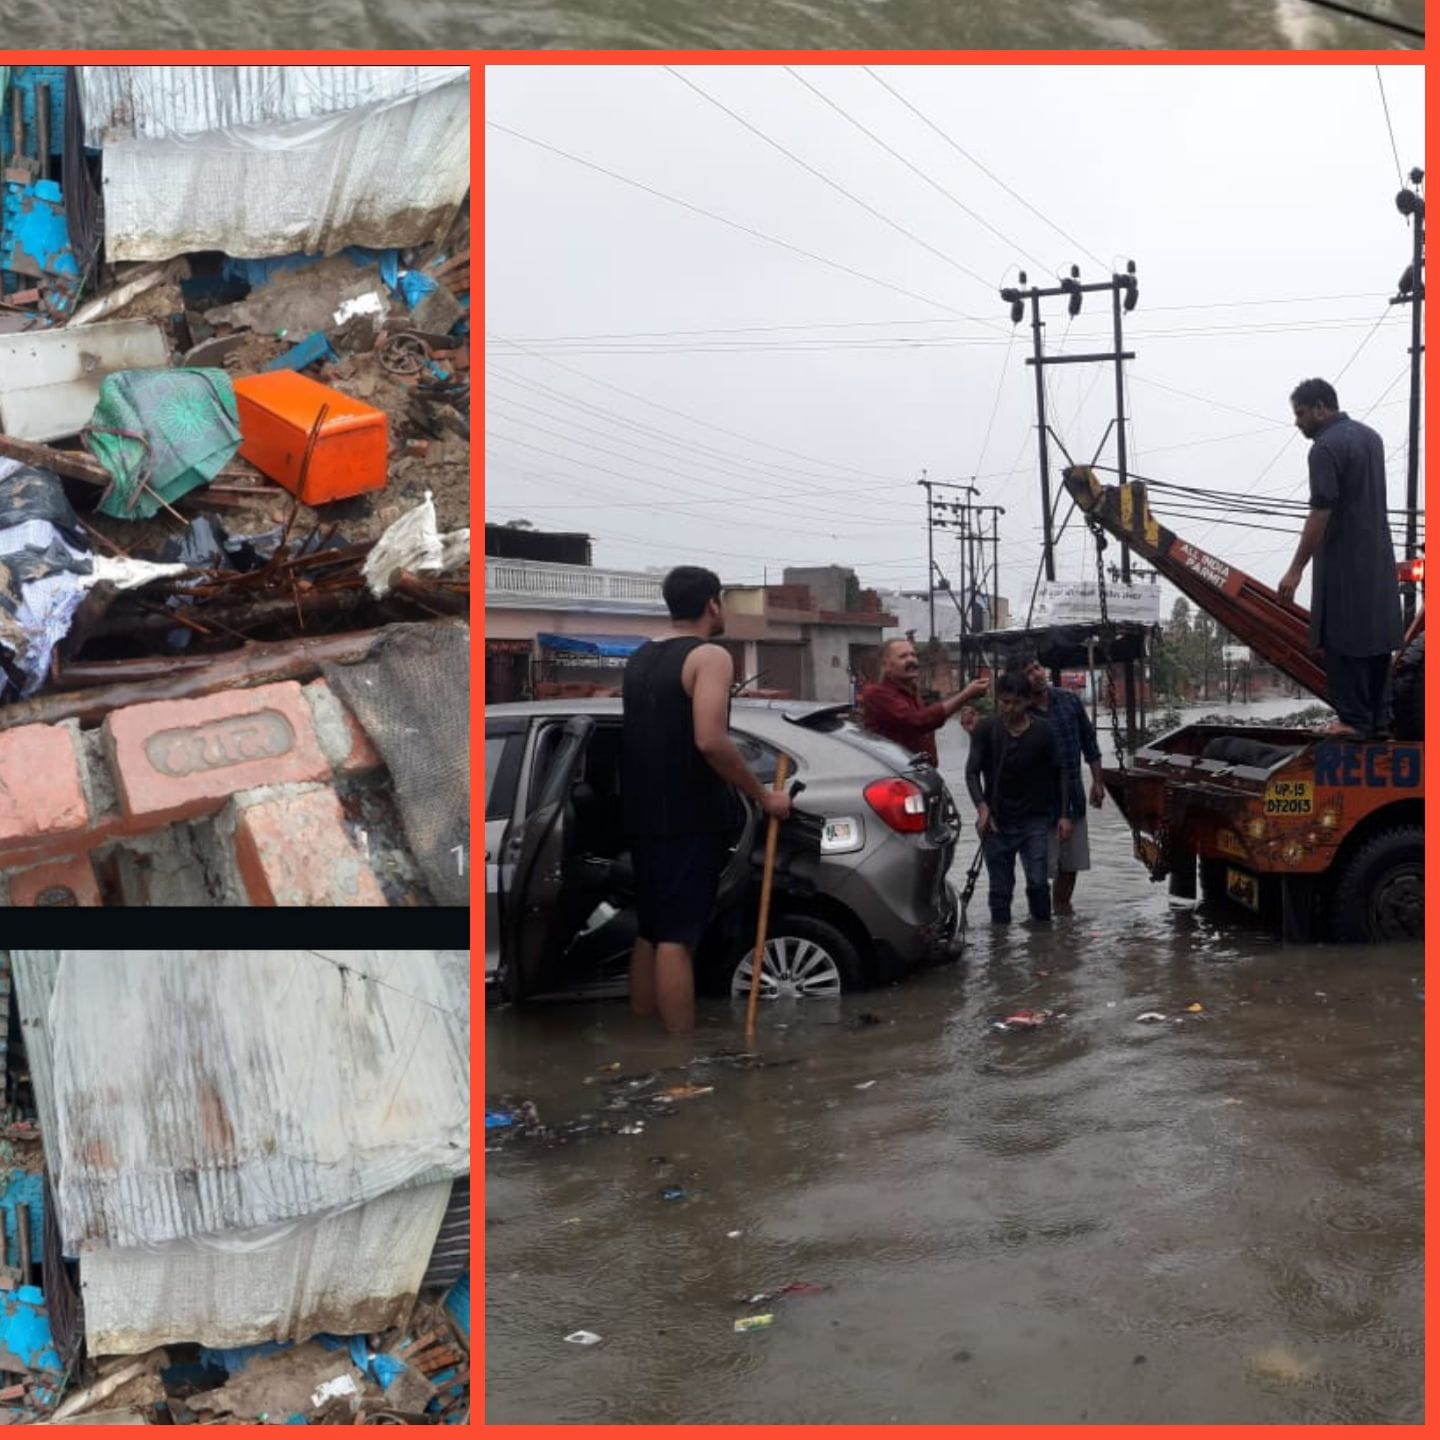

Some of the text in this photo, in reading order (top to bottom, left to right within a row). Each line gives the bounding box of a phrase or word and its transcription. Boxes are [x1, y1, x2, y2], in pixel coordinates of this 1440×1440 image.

[1180, 544, 1229, 577] ALL INDIA
[1314, 741, 1421, 788] RECO
